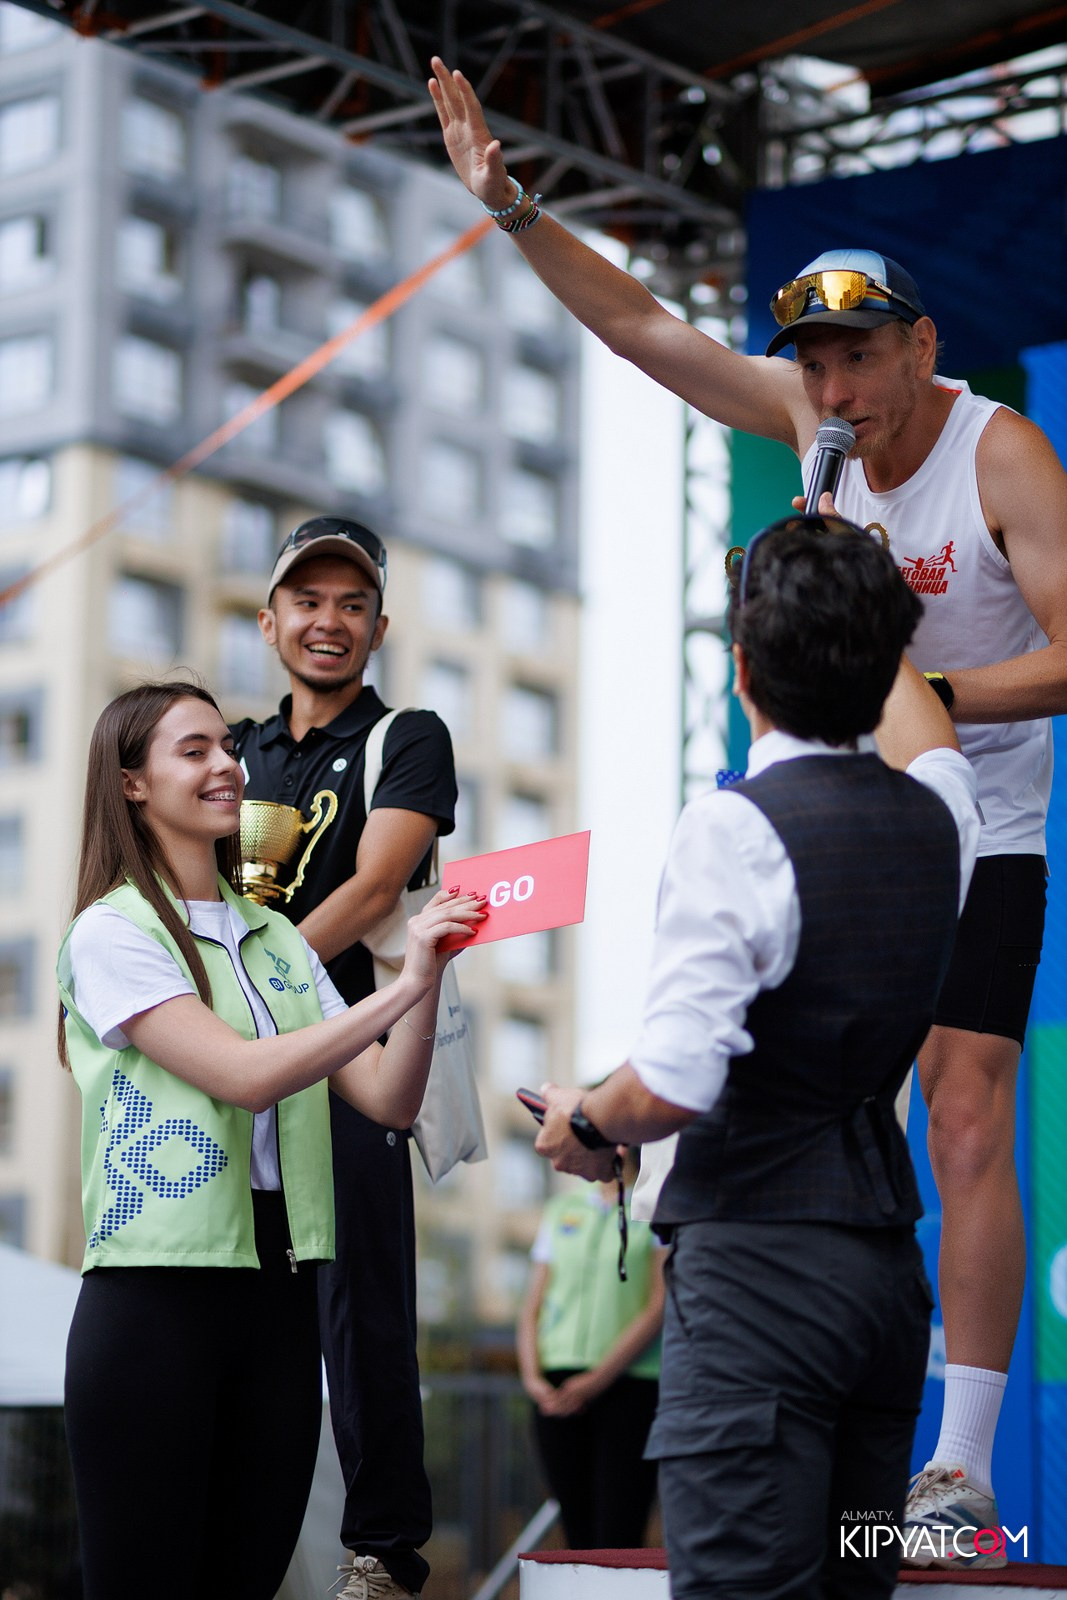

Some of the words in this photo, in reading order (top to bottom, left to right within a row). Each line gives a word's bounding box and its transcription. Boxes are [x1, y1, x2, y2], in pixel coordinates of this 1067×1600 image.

[897, 567, 946, 581] ЕГОВАЯ
[489, 875, 535, 908] GO
[270, 979, 283, 990] BI
